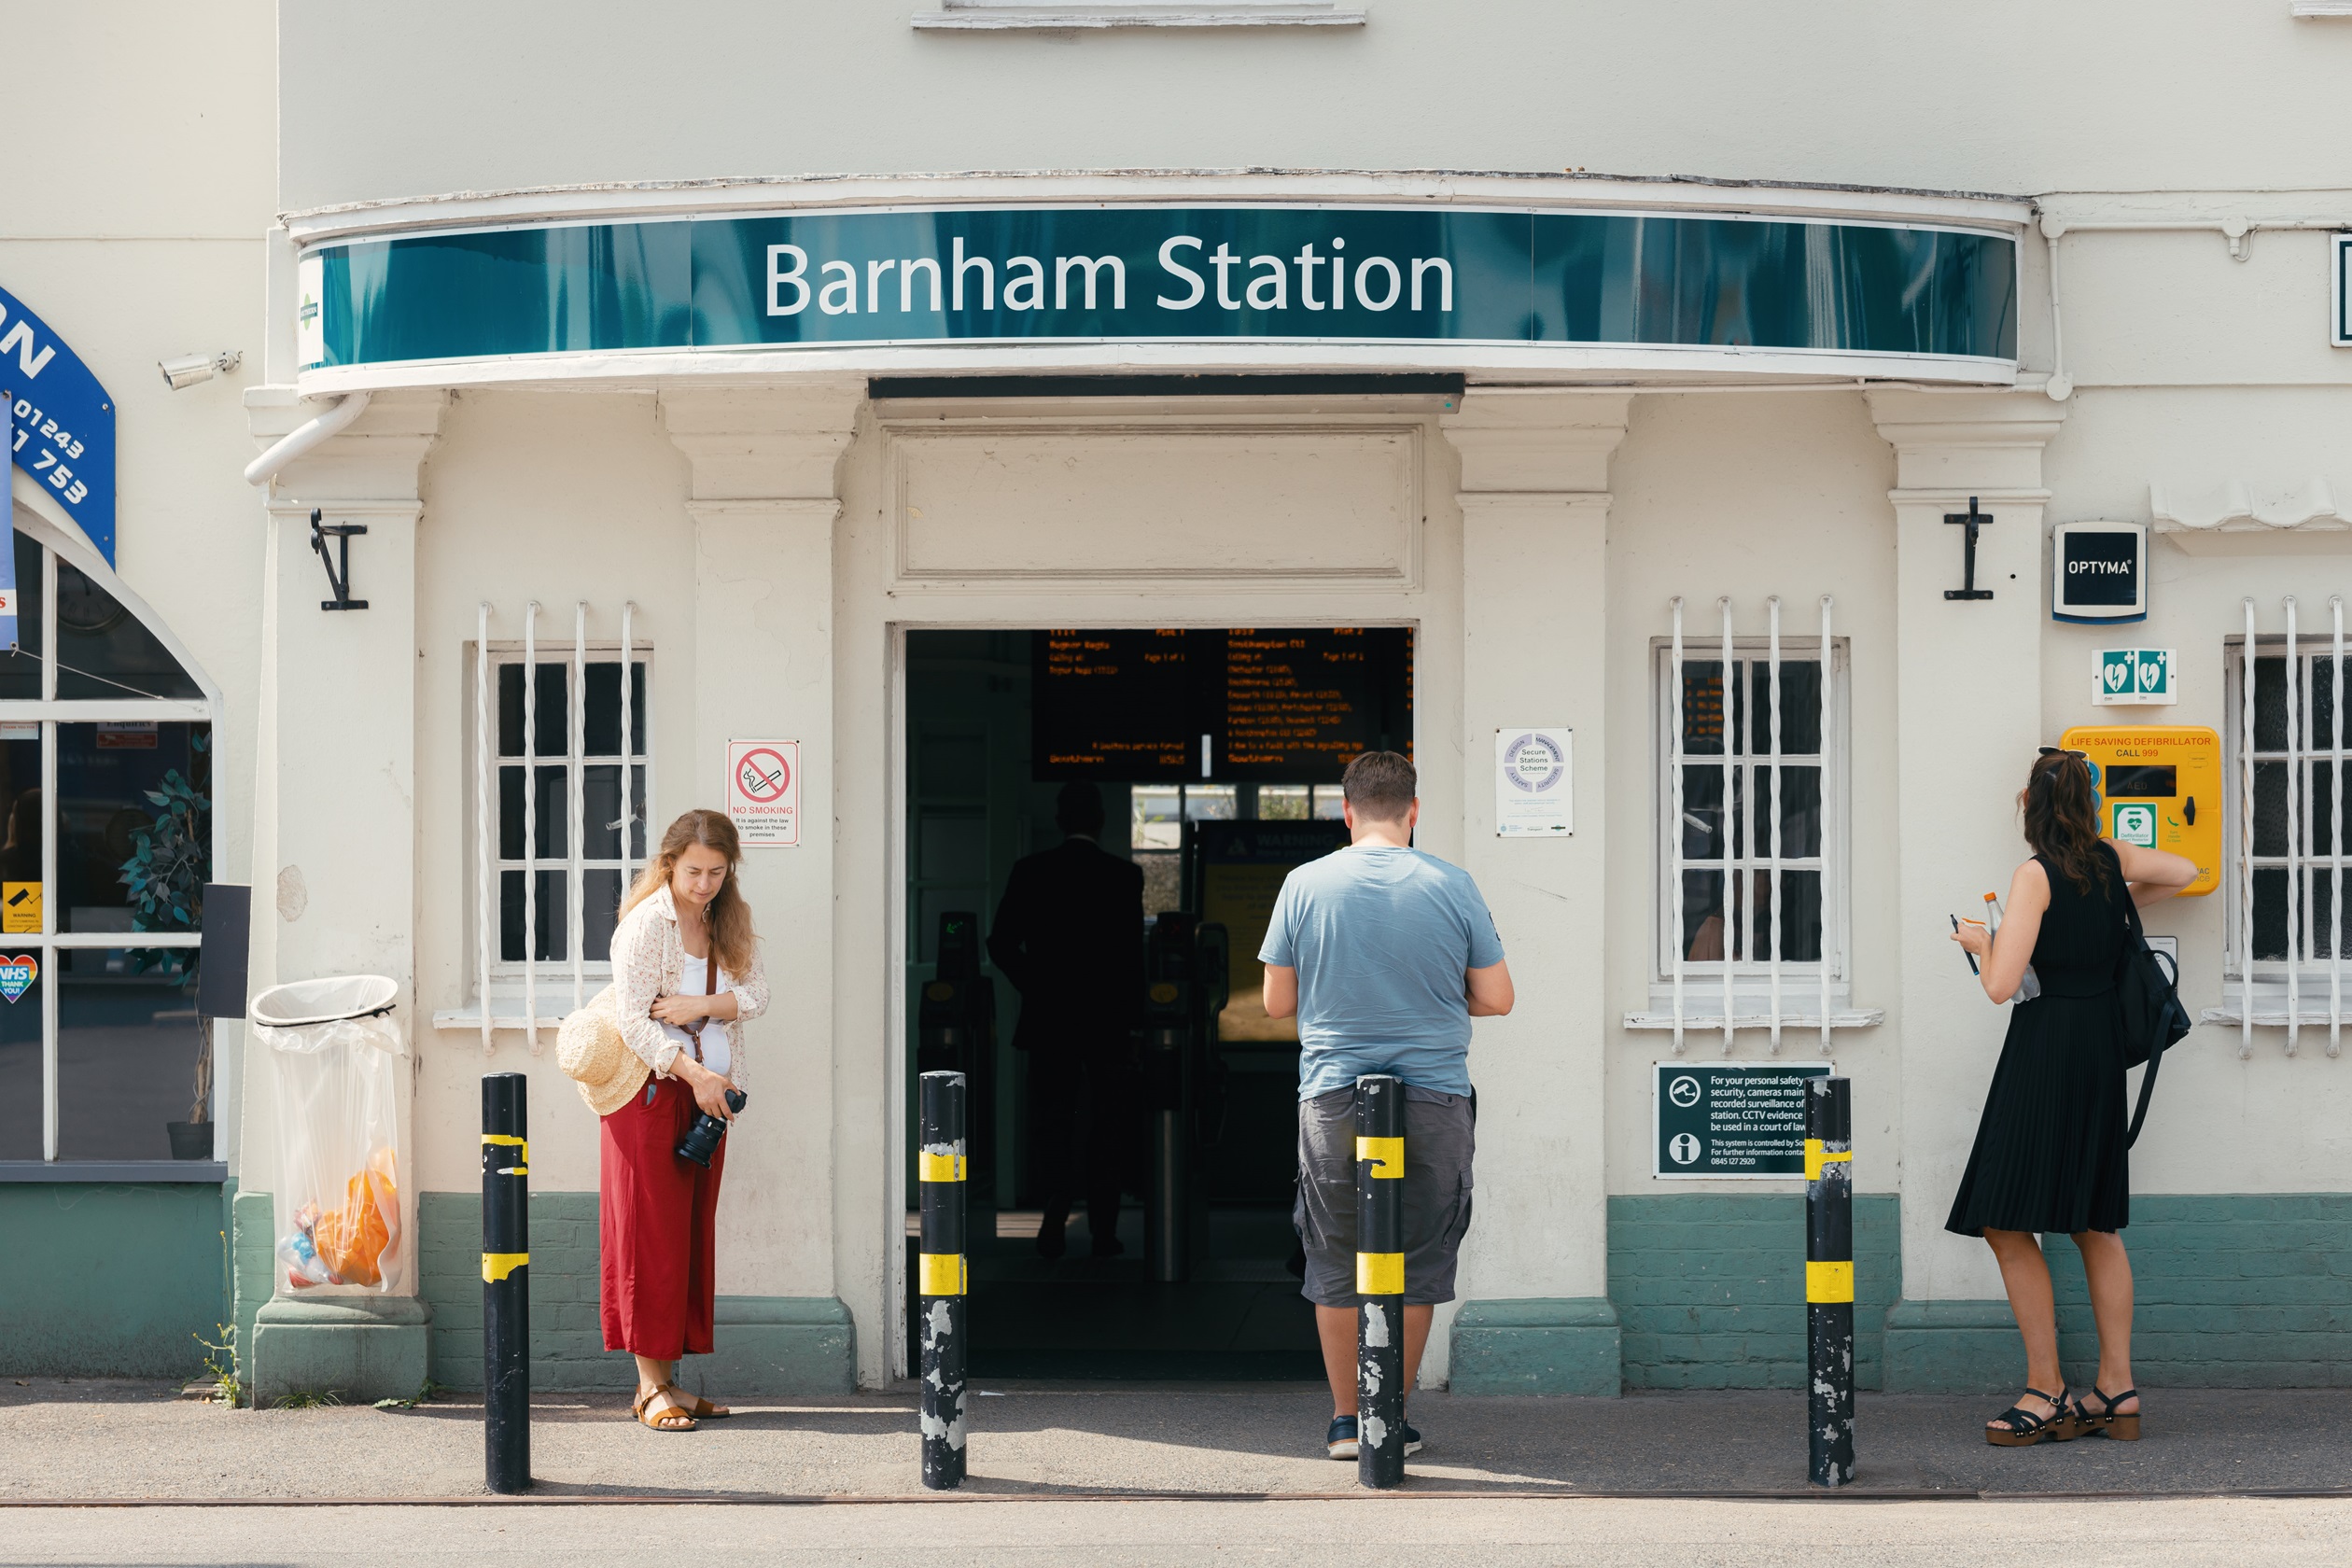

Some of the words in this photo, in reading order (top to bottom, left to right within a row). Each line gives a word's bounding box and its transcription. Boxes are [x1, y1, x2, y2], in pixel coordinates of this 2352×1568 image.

[766, 237, 1126, 315] Barnham
[1156, 235, 1453, 312] Station
[13, 399, 84, 459] 01243
[34, 448, 88, 505] 753
[2071, 737, 2092, 746] LIFE
[2094, 737, 2132, 746] SAVING
[2134, 737, 2211, 746] DEFIBRILLATOR
[1509, 740, 1525, 757] DESIGN
[1510, 772, 1528, 788] SAFETY
[1538, 768, 1559, 789] SECURITY
[1255, 833, 1336, 847] WARNING
[0, 967, 28, 980] NHS
[1711, 1076, 1723, 1085] For
[1725, 1078, 1743, 1087] your
[1744, 1076, 1779, 1087] personal
[1780, 1076, 1803, 1087] safety
[1710, 1088, 1745, 1098] security,
[1784, 1088, 1805, 1097] main
[1711, 1099, 1746, 1108] recorded
[1747, 1099, 1794, 1108] surveillance
[1796, 1099, 1805, 1108] of
[1710, 1111, 1741, 1119] station.
[1742, 1111, 1766, 1119] CCTV
[1767, 1111, 1803, 1119] evidence
[1711, 1123, 1721, 1131] be
[1723, 1123, 1742, 1131] used
[1743, 1123, 1751, 1131] in
[1759, 1123, 1781, 1131] court
[1783, 1122, 1792, 1131] of
[1786, 1140, 1794, 1148] by
